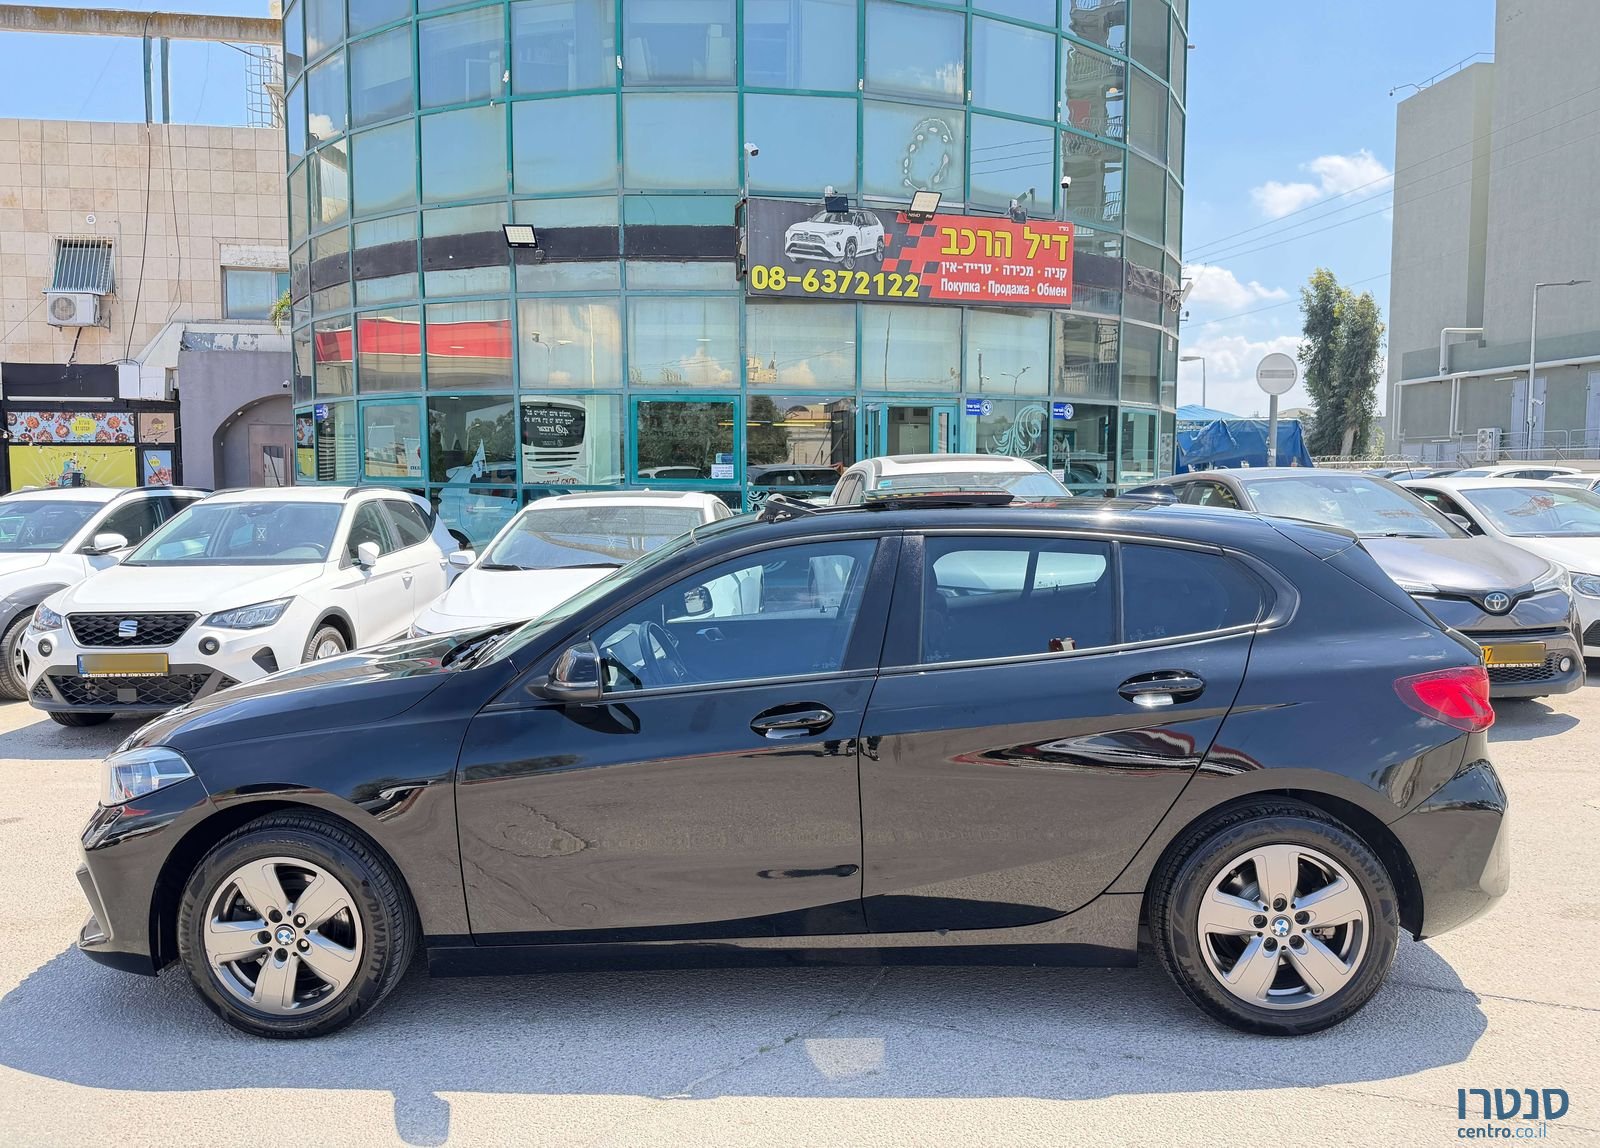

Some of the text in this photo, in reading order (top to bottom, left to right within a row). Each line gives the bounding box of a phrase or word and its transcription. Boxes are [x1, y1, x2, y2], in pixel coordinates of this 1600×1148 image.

[941, 226, 1070, 261] דיל הרכב
[751, 265, 919, 298] 08-6372122
[941, 261, 1068, 281] קניה מכירה טרייד-אין
[940, 278, 1067, 297] Покупка Продажа Обмен
